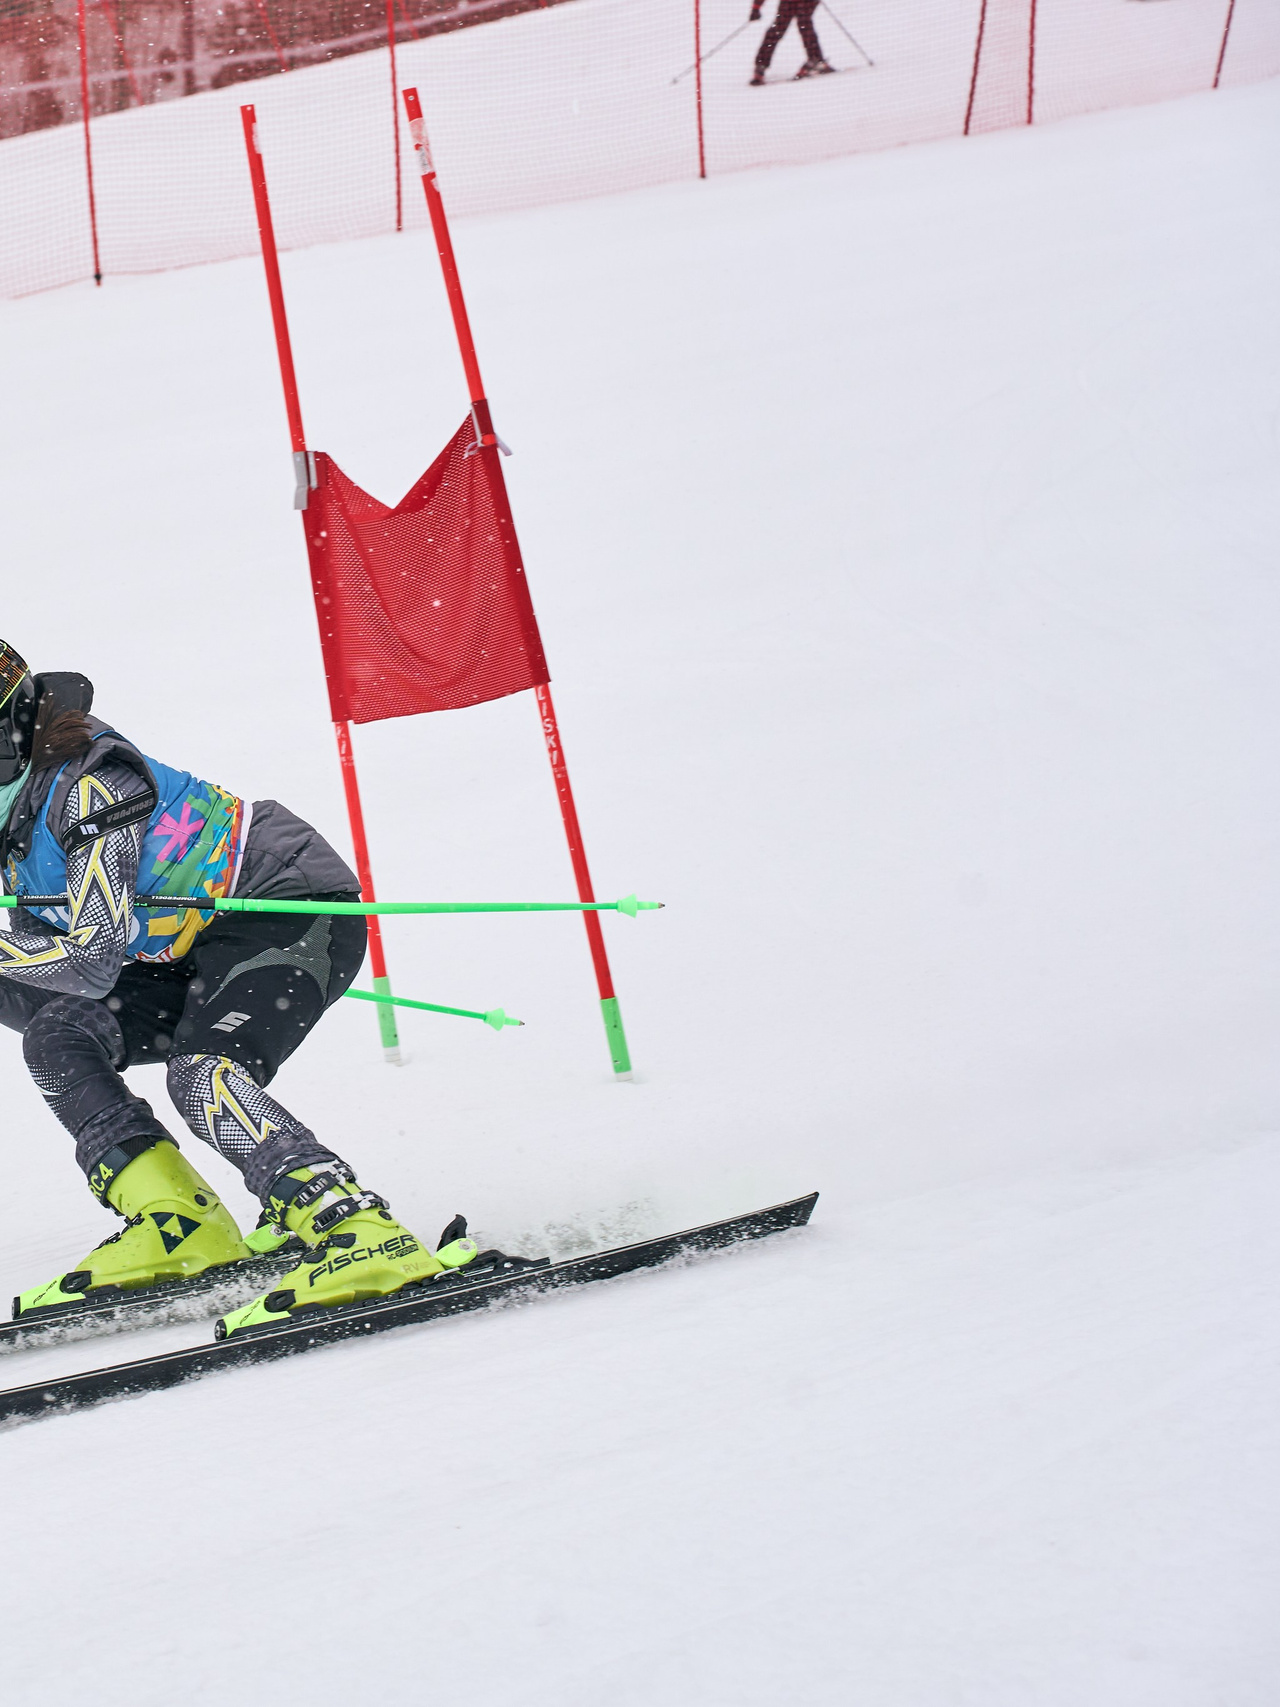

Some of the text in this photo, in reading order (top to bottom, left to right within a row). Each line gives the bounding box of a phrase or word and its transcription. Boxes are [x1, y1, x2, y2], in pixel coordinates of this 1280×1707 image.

[537, 685, 558, 765] LISKI
[89, 1162, 114, 1201] RC4
[265, 1195, 286, 1226] C4
[309, 1234, 417, 1288] FISCHER
